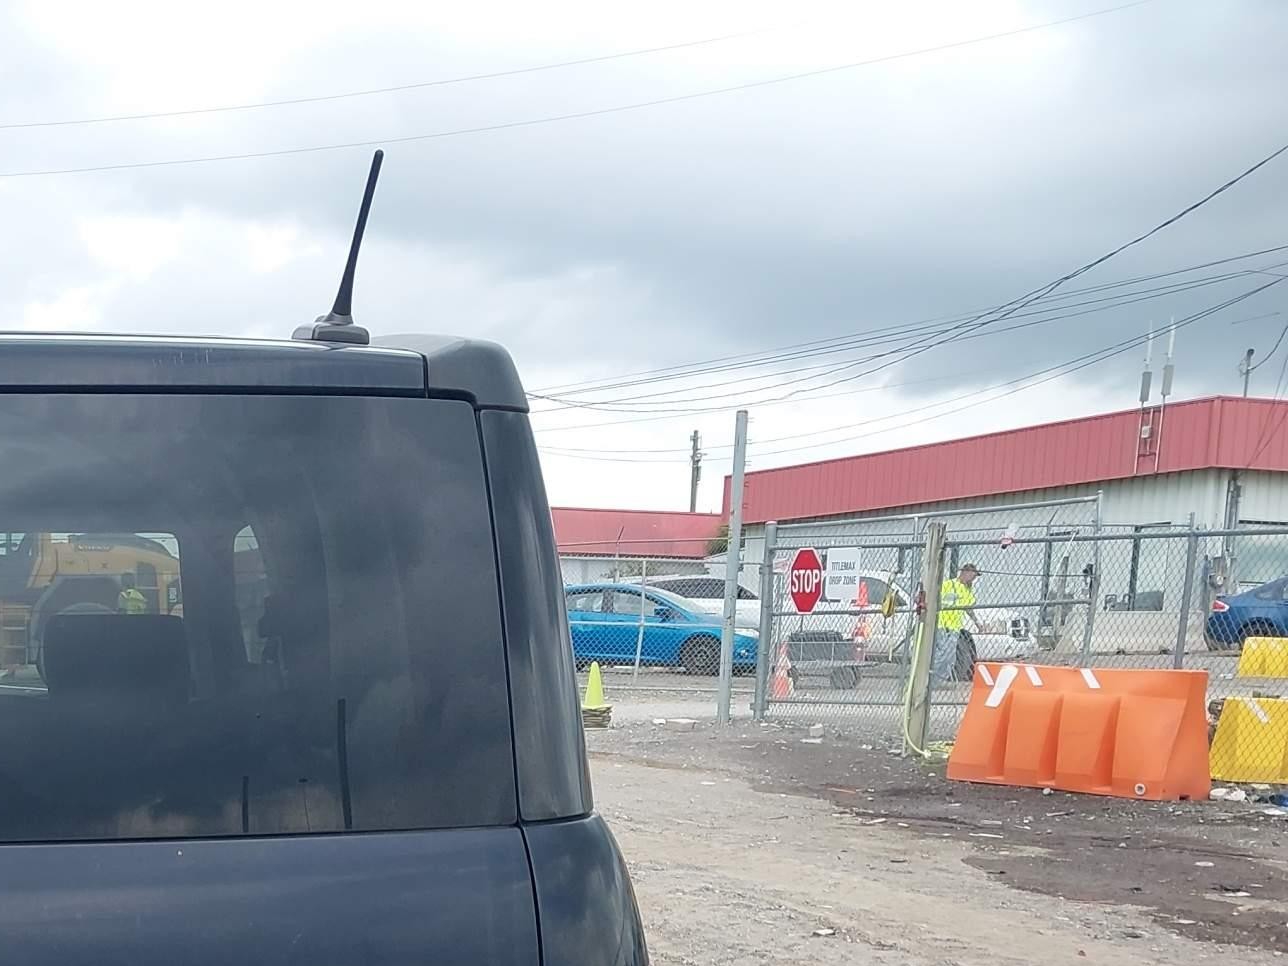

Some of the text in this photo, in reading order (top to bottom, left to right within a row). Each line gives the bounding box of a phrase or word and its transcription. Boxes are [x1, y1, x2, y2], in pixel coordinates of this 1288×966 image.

[792, 569, 820, 593] STOP
[829, 575, 857, 585] DROP ZONE
